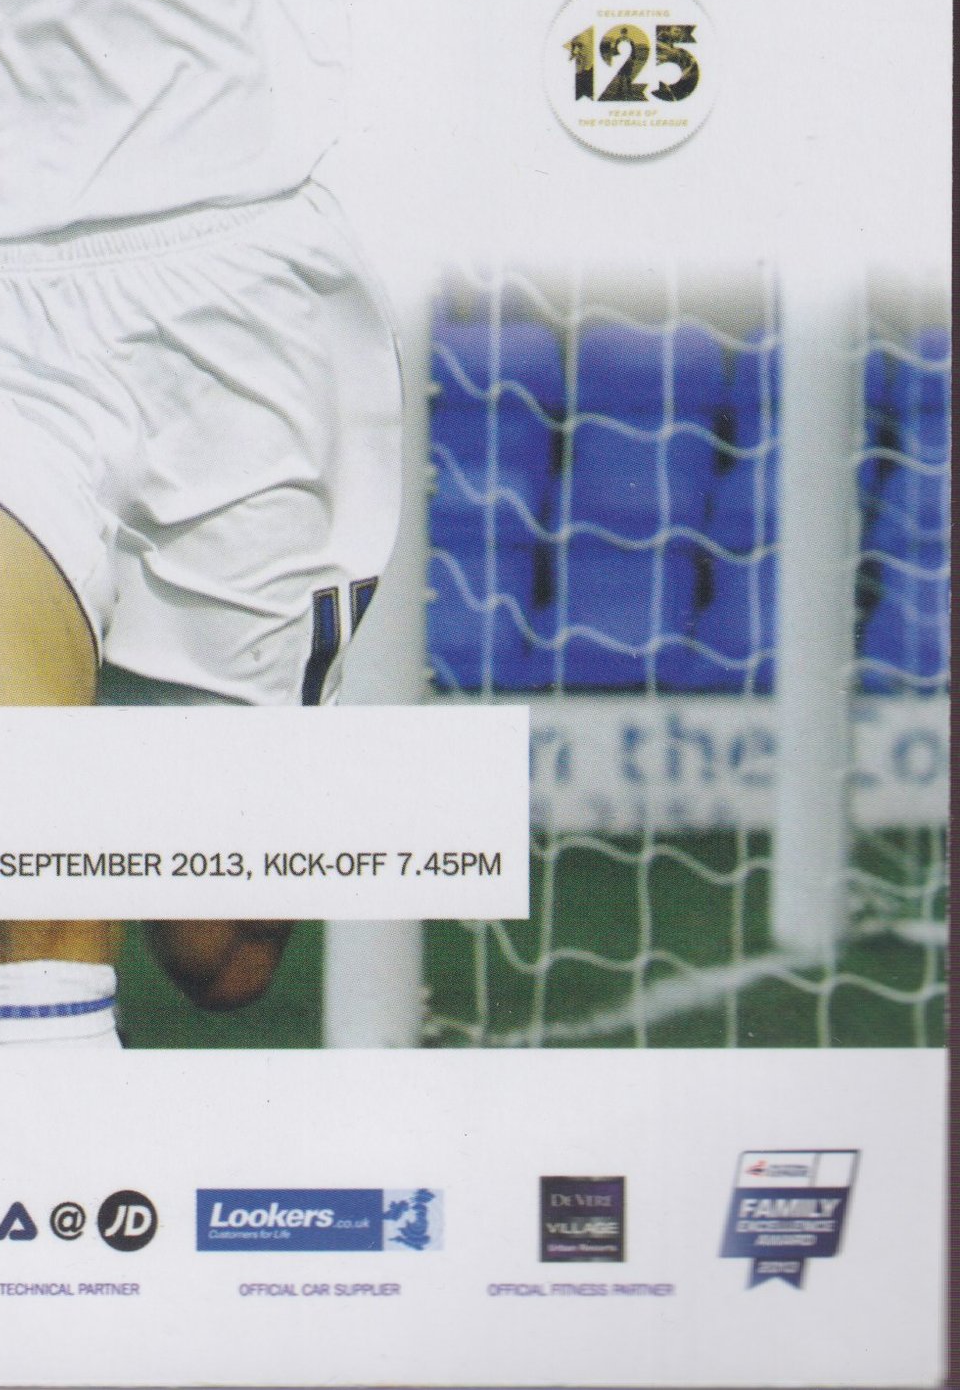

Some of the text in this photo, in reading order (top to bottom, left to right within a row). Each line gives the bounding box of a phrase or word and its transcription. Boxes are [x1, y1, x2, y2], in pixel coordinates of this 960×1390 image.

[562, 23, 701, 102] 125
[0, 853, 162, 877] SEPTEMBER
[172, 852, 252, 881] 2013,
[264, 852, 387, 876] KICK-OFF
[397, 852, 501, 876] 7.45PM
[104, 1205, 152, 1237] JD
[208, 1230, 290, 1239] Customers for Life
[546, 1223, 620, 1234] VILLAGE
[0, 1283, 74, 1296] TECHNICAL
[79, 1283, 140, 1296] PARTNER
[239, 1283, 401, 1296] OFFICIAL CAR SUPPLIER
[488, 1283, 546, 1296] OFFICIAL
